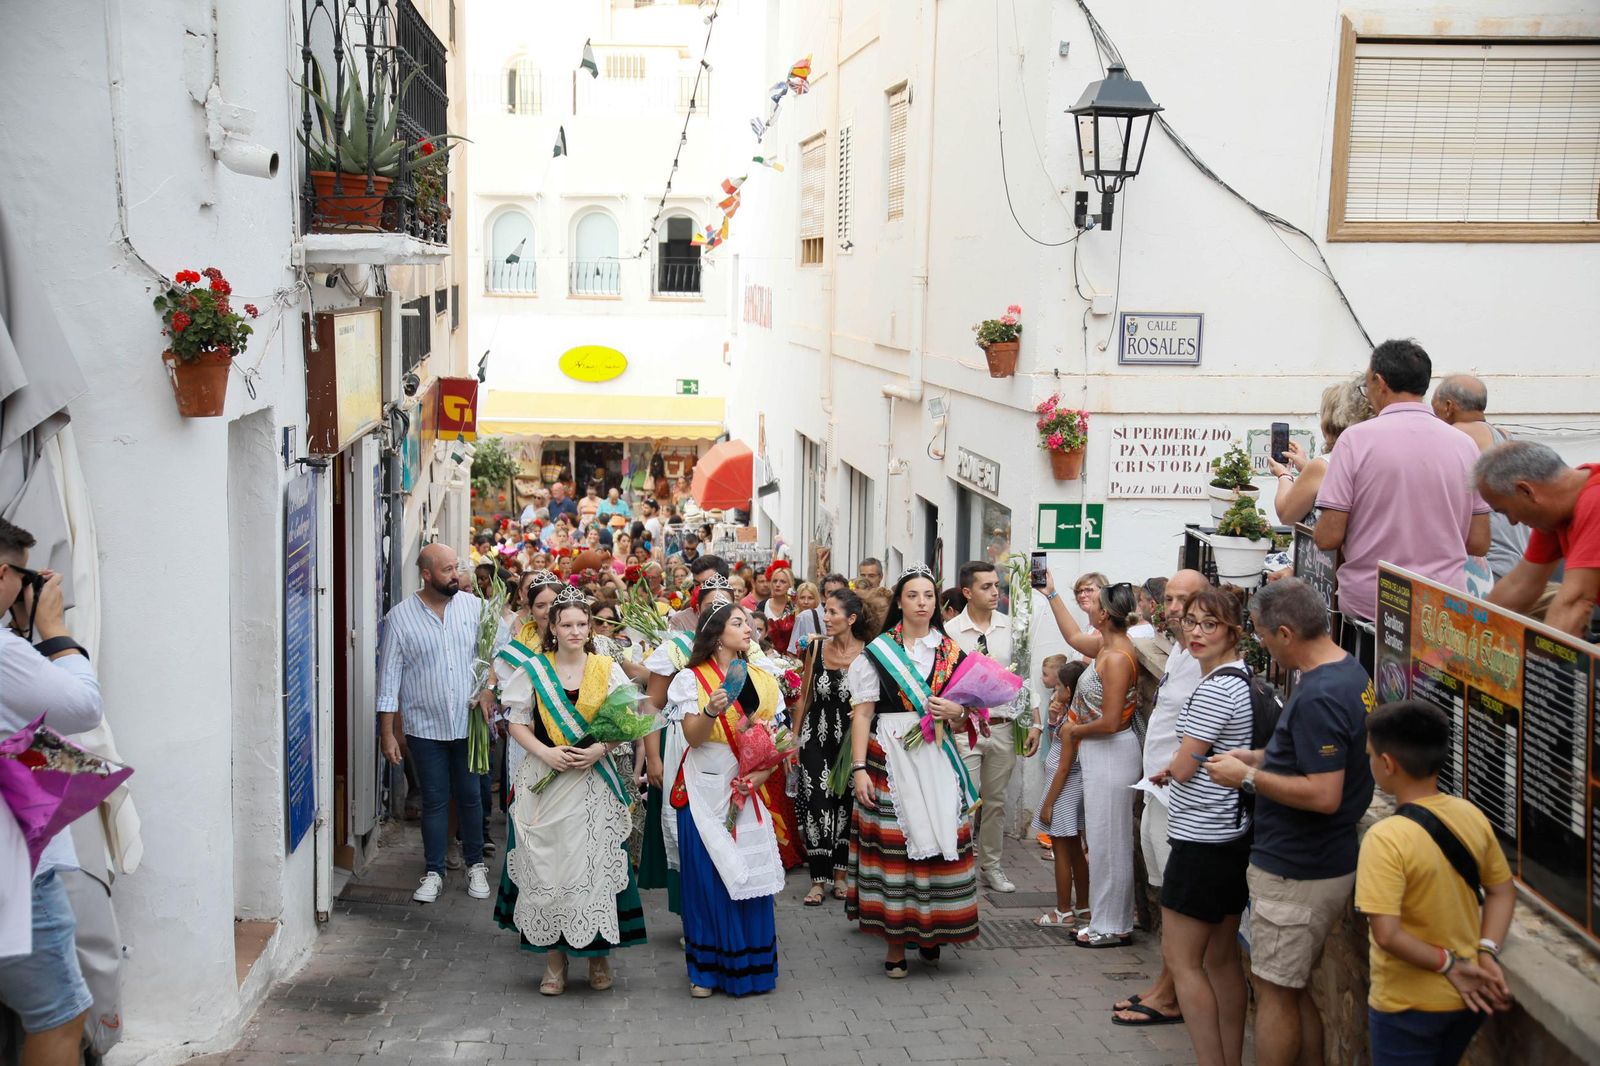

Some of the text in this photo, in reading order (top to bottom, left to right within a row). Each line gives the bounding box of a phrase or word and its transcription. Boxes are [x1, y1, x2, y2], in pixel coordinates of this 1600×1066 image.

[1147, 320, 1177, 331] CALLE
[1127, 337, 1196, 355] ROSALES
[1113, 427, 1231, 441] SUPERMERCADO
[1120, 444, 1209, 457] PANADERIA
